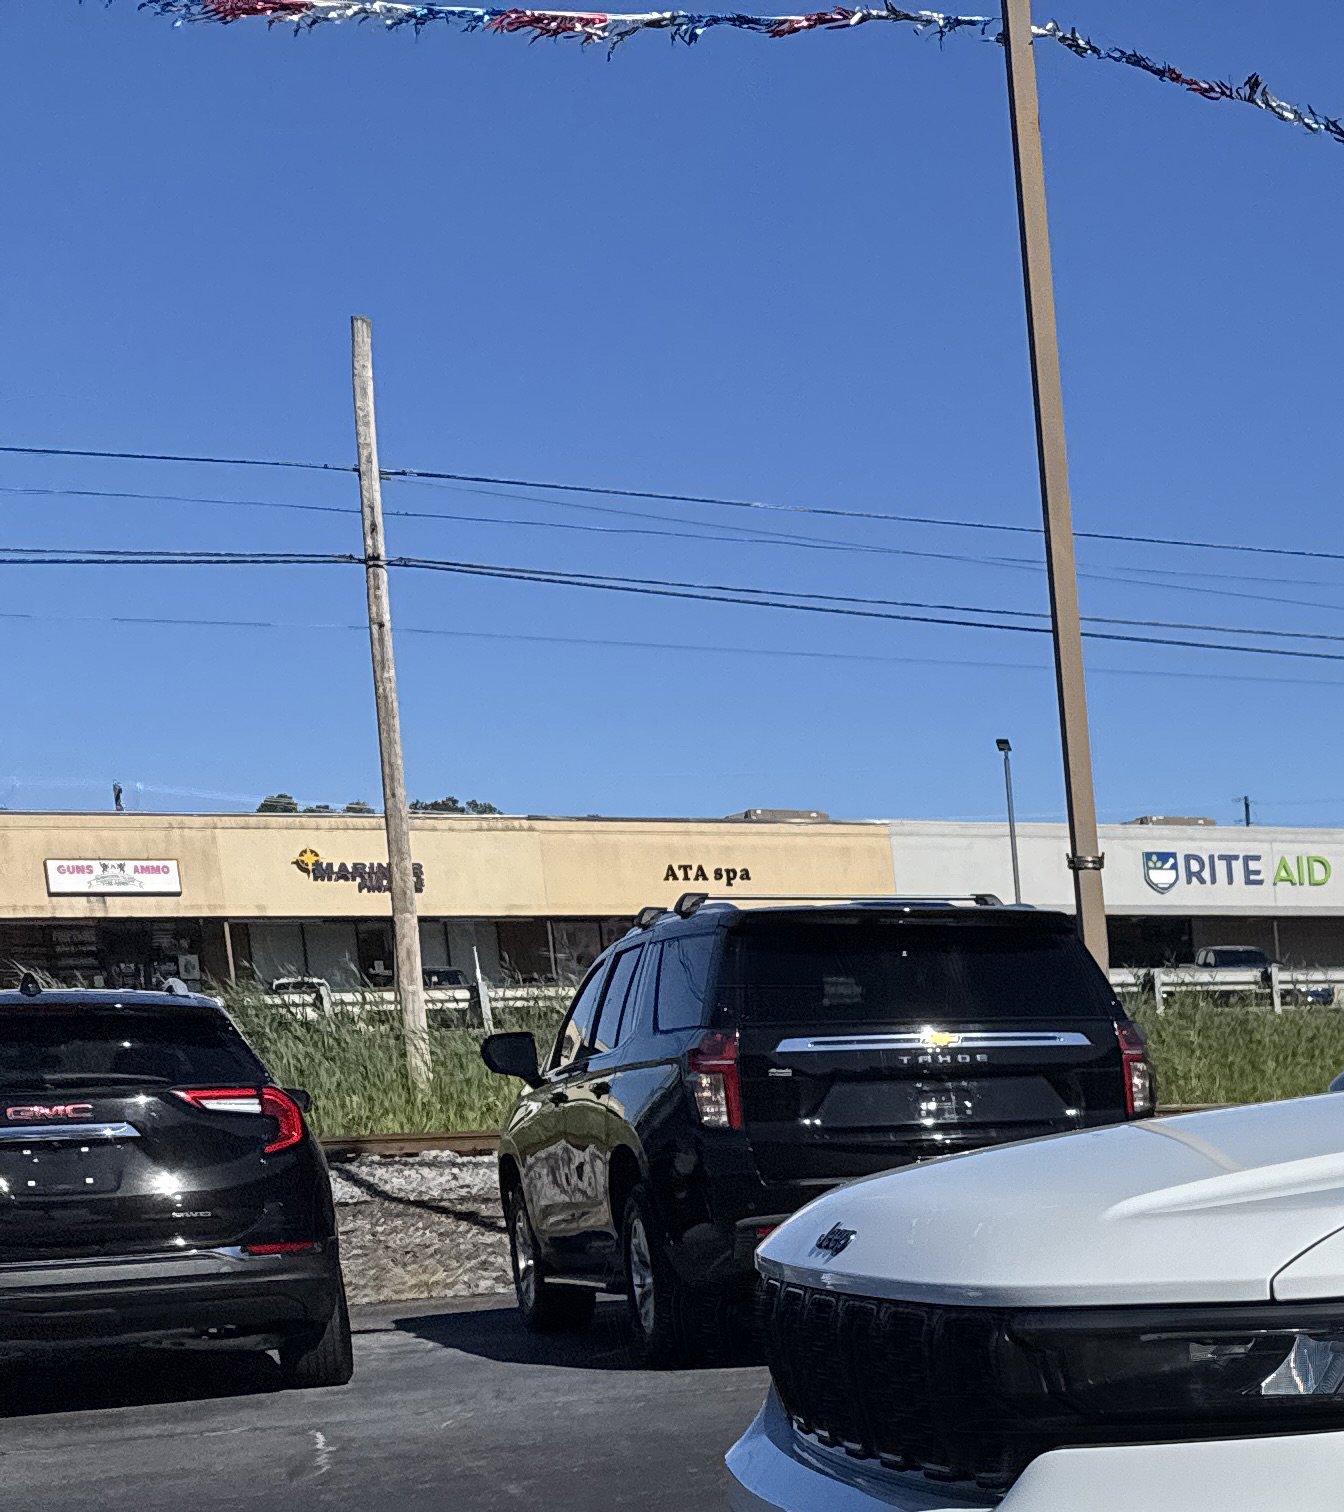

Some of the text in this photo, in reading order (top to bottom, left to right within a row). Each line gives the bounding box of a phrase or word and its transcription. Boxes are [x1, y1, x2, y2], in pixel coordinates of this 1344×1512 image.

[57, 864, 170, 875] GUNS AMMO
[313, 862, 424, 881] MARINR
[663, 864, 751, 886] ATA spa
[1183, 853, 1332, 886] RITE AID
[898, 1054, 988, 1064] TAHOE
[6, 1103, 94, 1120] GMC
